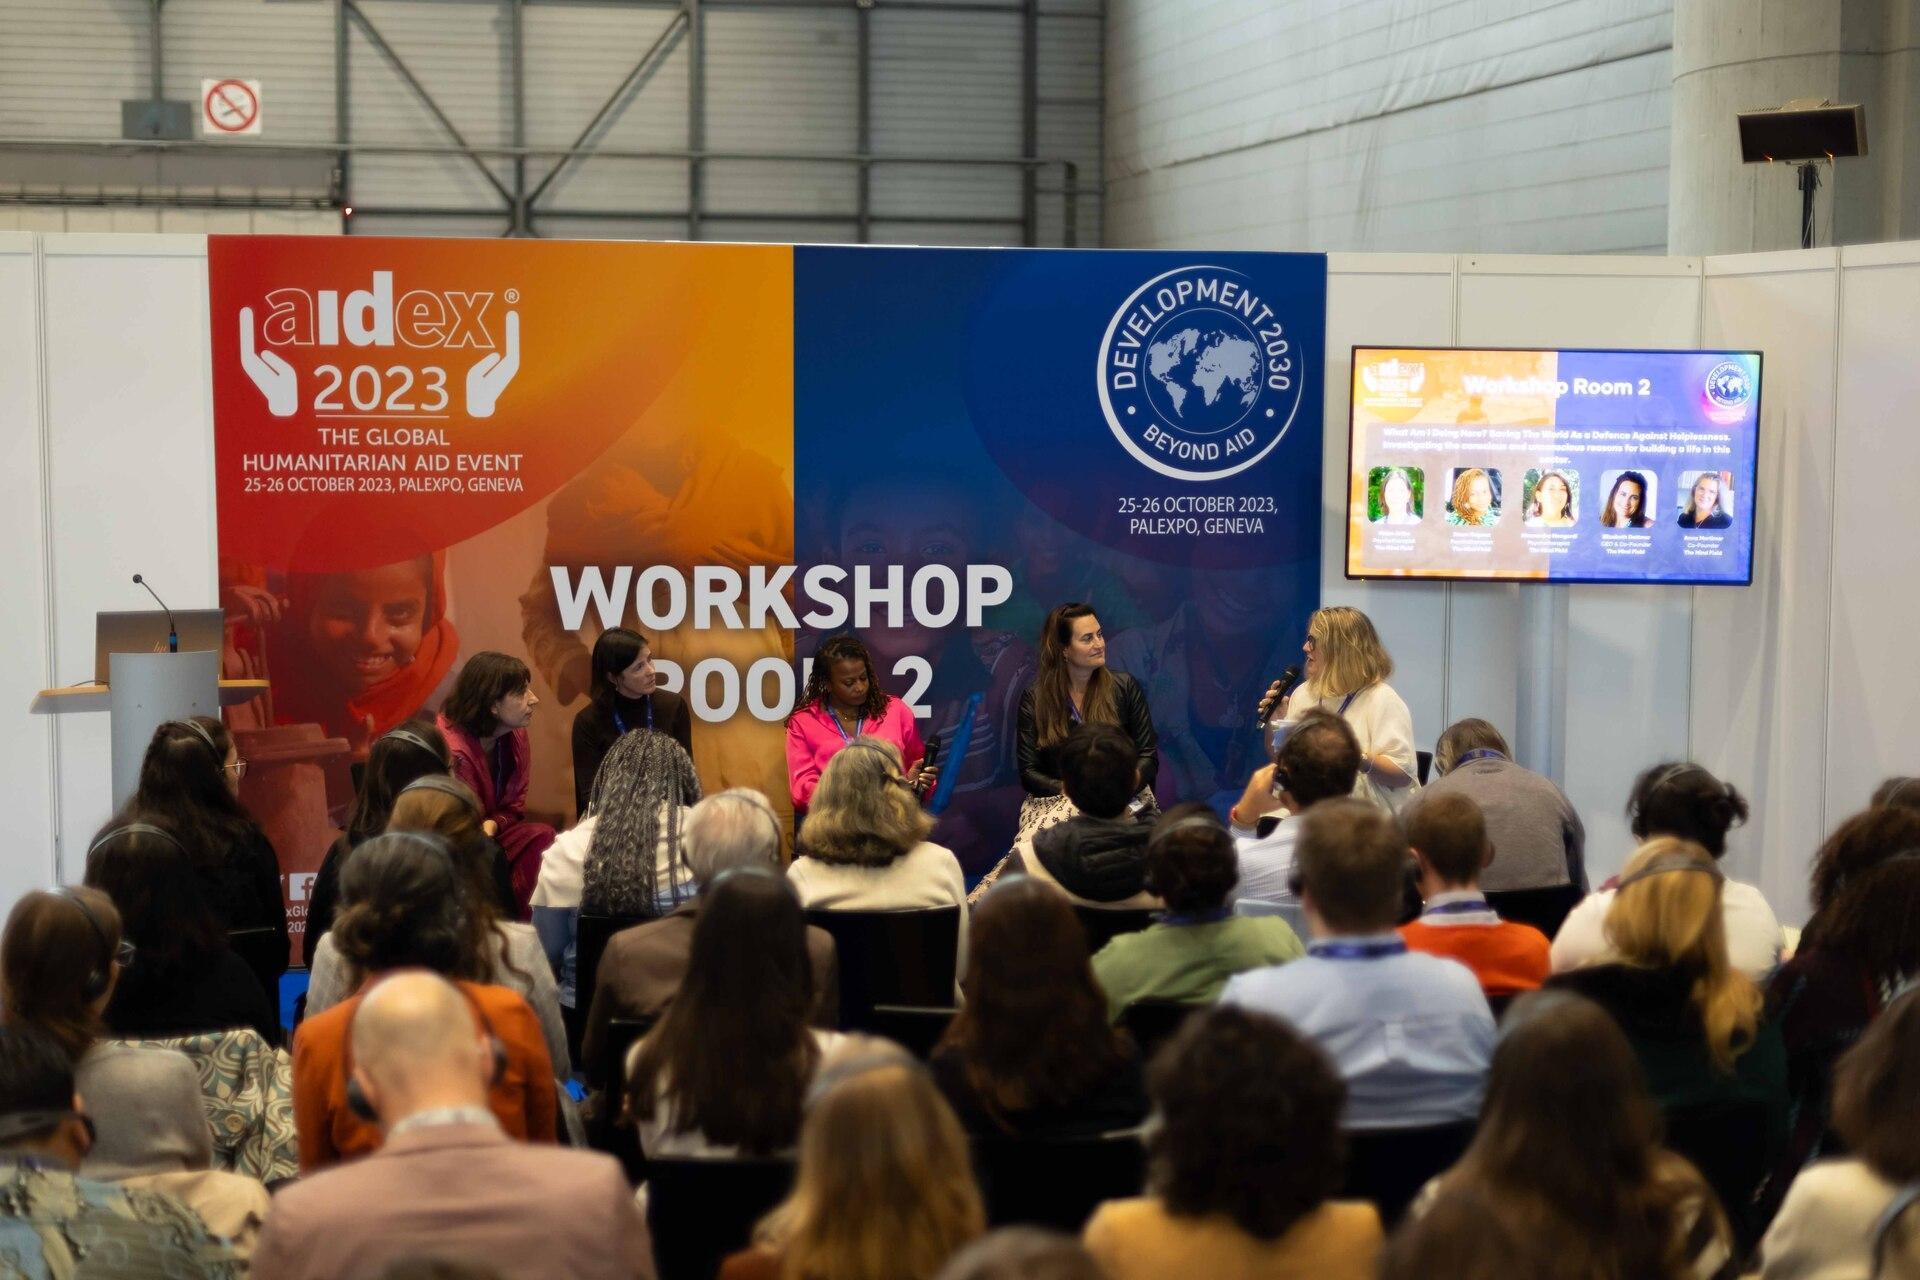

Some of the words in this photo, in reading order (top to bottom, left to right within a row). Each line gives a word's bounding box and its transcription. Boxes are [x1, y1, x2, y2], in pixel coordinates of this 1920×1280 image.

[263, 271, 495, 348] aidex
[314, 365, 448, 411] 2023
[1464, 376, 1568, 398] Workshop
[1573, 378, 1632, 395] Room
[1638, 379, 1650, 396] 2
[318, 428, 359, 446] THE
[366, 428, 450, 446] GLOBAL
[1143, 424, 1219, 460] BEYOND
[1225, 428, 1255, 456] AID
[1384, 428, 1408, 436] What
[1570, 431, 1583, 439] As
[1592, 431, 1631, 440] Defence
[1632, 431, 1668, 441] Against
[1586, 444, 1623, 452] reasons
[1624, 444, 1638, 452] for
[1639, 444, 1677, 455] building
[1686, 445, 1701, 454] life
[1713, 446, 1731, 454] this
[243, 454, 406, 471] HUMANITARIAN
[415, 455, 450, 471] AID
[457, 455, 523, 471] EVENT
[244, 477, 284, 491] 25-26
[288, 477, 354, 491] OCTOBER
[359, 478, 395, 493] 2023,
[399, 478, 465, 493] PALEXPO,
[470, 478, 523, 491] GENEVA
[1118, 497, 1159, 513] 25-26
[1164, 497, 1235, 513] OCTOBER
[1239, 497, 1278, 514] 2023,
[1130, 518, 1200, 536] PALEXPO,
[1204, 518, 1264, 534] GENEVA
[550, 564, 1013, 630] WORKSHOP
[654, 655, 818, 723] OO
[892, 656, 932, 719] 2
